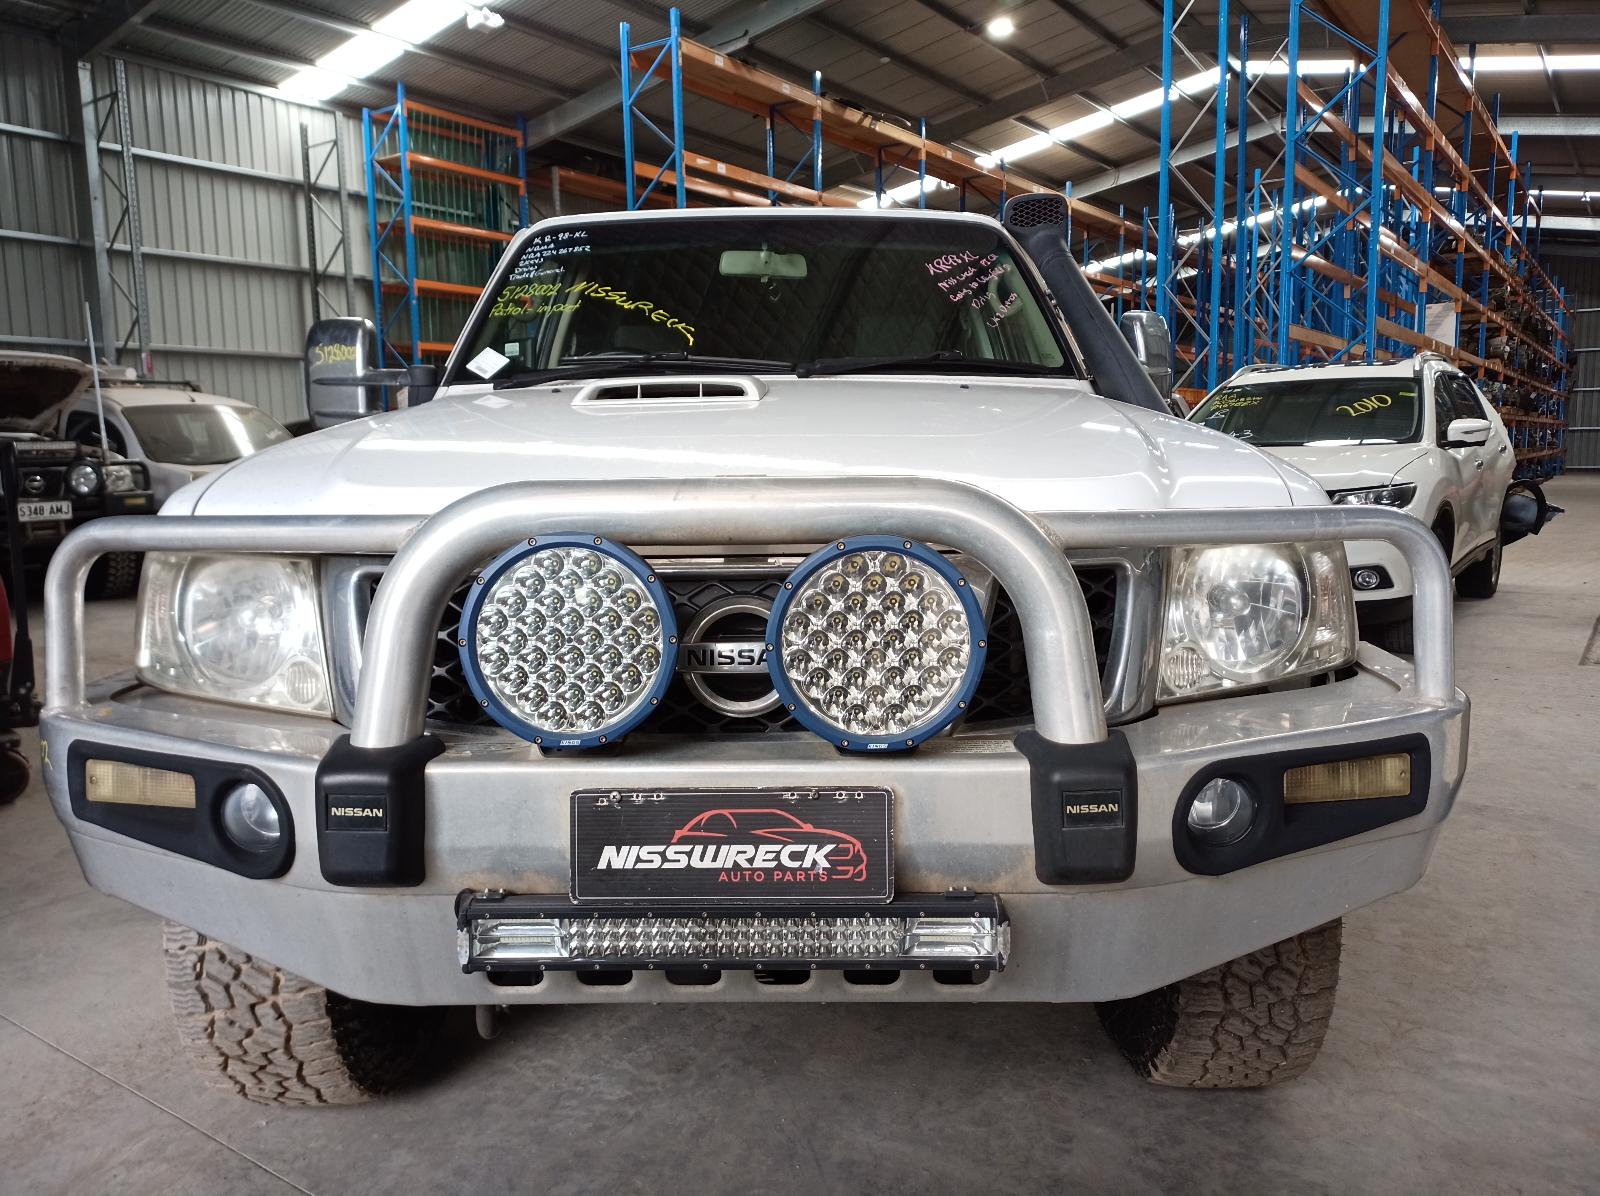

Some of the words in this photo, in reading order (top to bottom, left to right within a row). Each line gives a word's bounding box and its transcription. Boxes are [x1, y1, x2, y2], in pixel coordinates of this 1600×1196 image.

[1335, 394, 1392, 416] 2010
[49, 503, 70, 515] AMJ
[331, 807, 383, 817] NISSAN
[1066, 803, 1119, 814] NISSAN
[597, 844, 837, 869] NISSWRECK
[718, 871, 765, 882] AUTO
[773, 871, 829, 882] PARTS
